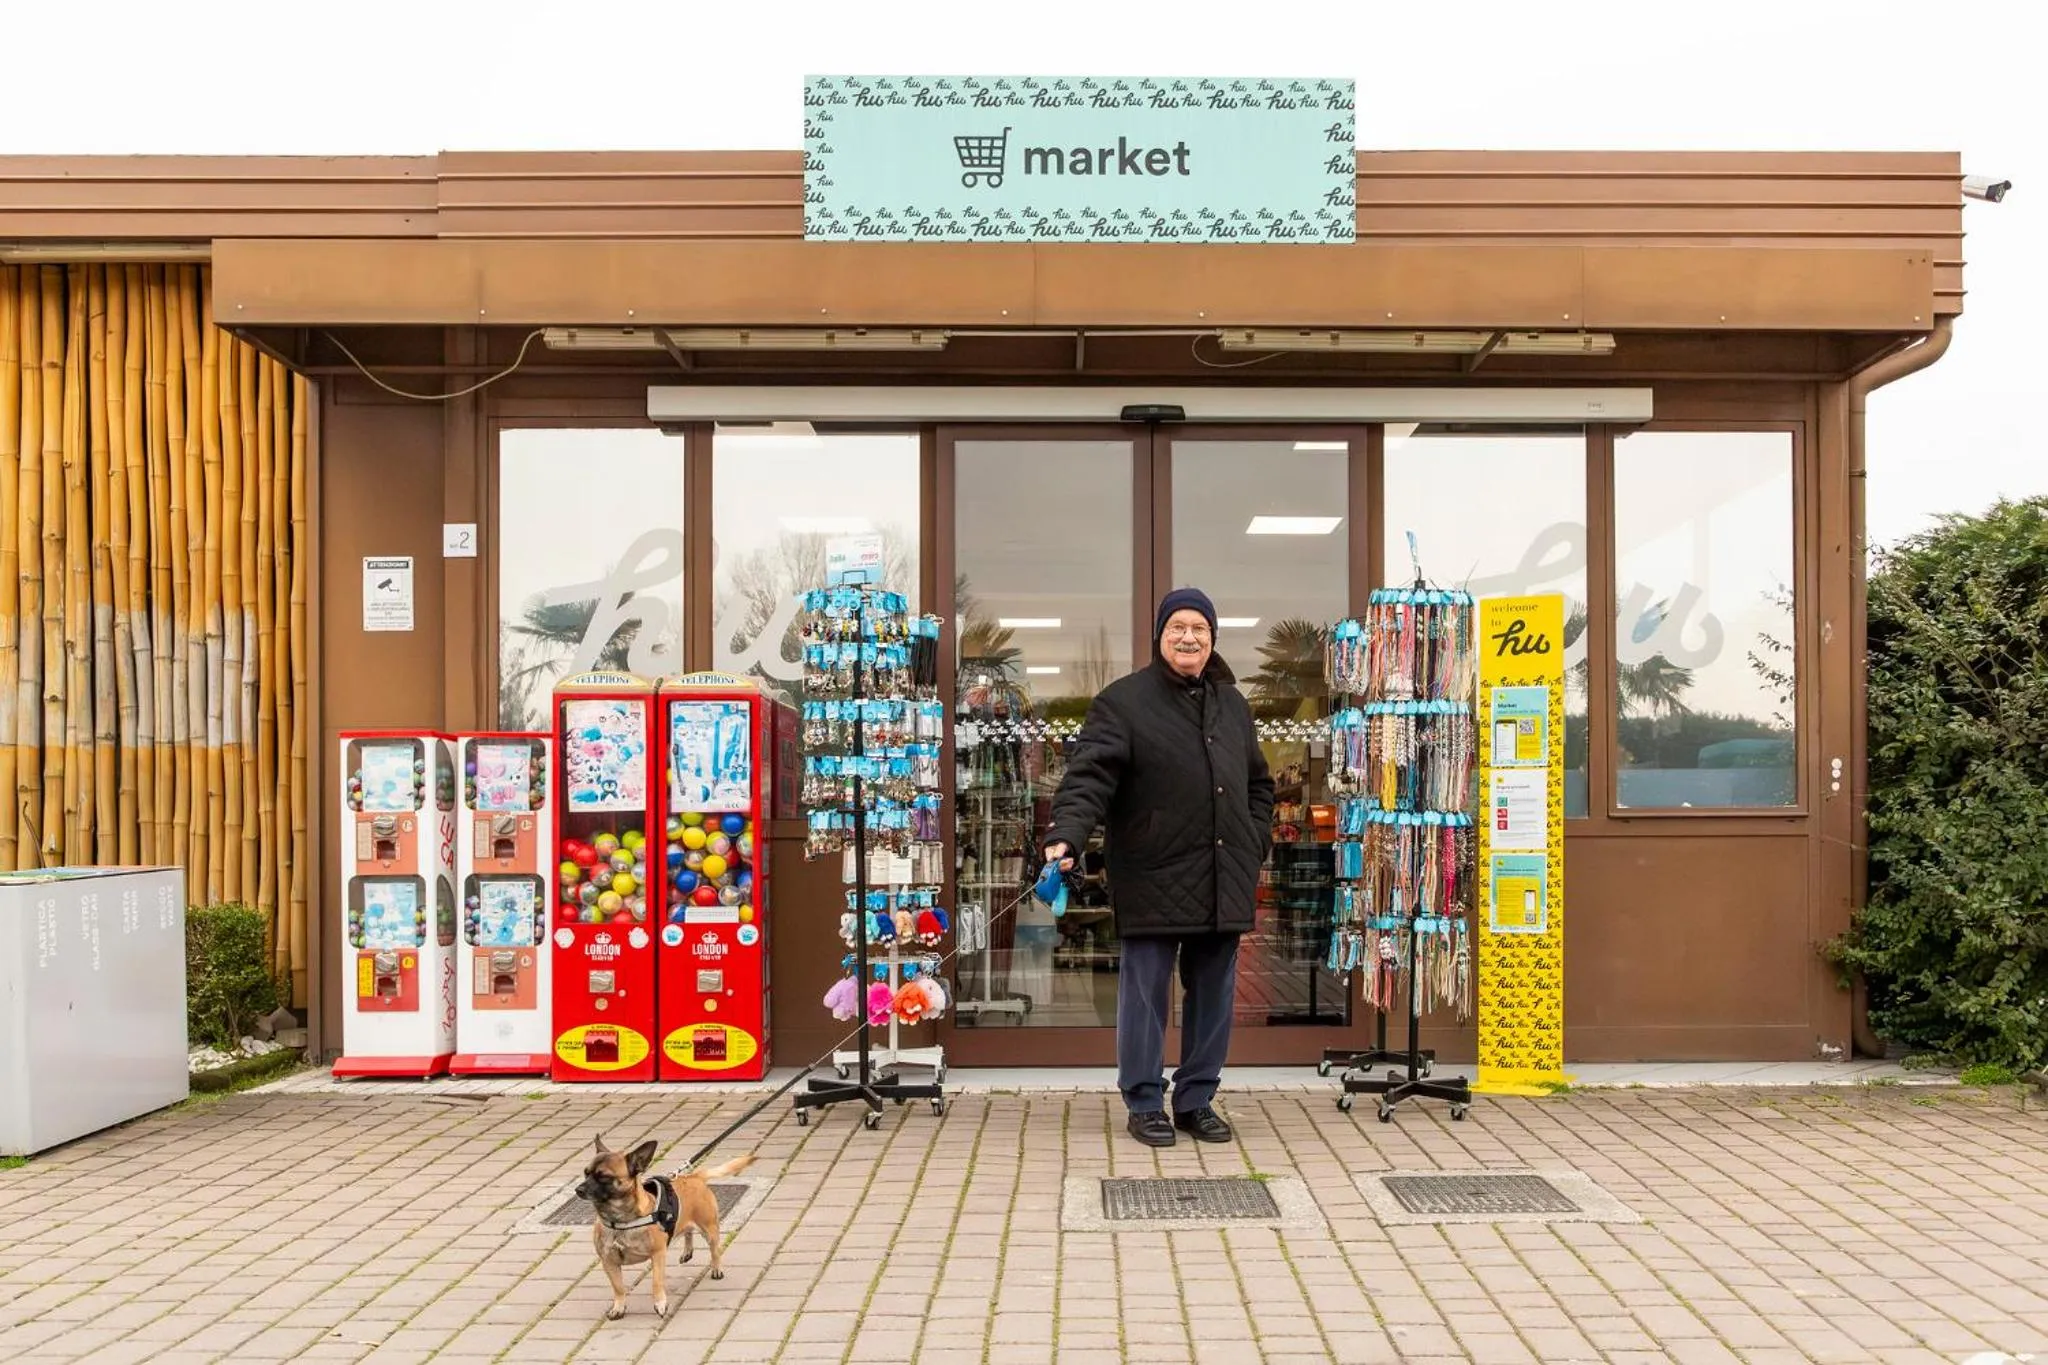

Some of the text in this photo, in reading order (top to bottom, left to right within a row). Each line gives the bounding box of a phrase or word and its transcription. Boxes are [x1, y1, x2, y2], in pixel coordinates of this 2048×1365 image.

[816, 76, 1333, 92] hu hu hu hu hu hu hu hu hu hu hu hu hu hu hu hu hu hu
[826, 91, 848, 104] hu
[852, 87, 884, 107] hu
[885, 91, 907, 104] hu
[911, 87, 943, 108] hu
[944, 91, 966, 105] hu
[970, 88, 1002, 108] hu
[1004, 92, 1025, 106] hu
[1029, 88, 1061, 108] hu
[1063, 92, 1084, 106] hu
[1088, 88, 1120, 108] hu
[1122, 92, 1143, 106] hu
[1148, 88, 1179, 108] hu
[1181, 92, 1202, 107] hu
[1206, 90, 1238, 109] hu
[1240, 94, 1260, 107] hu
[1265, 90, 1296, 110] hu
[1298, 94, 1319, 108] hu
[1324, 90, 1355, 110] hu
[817, 110, 833, 121] hu
[1324, 122, 1355, 142] hu
[817, 143, 834, 154] hu
[1024, 136, 1190, 176] market
[1324, 154, 1355, 174] hu
[816, 174, 834, 186] hu
[1324, 187, 1355, 206] hu
[816, 207, 833, 219] hu
[844, 205, 862, 217] hu
[876, 207, 893, 219] hu
[903, 206, 921, 217] hu
[935, 207, 952, 219] hu
[963, 206, 980, 218] hu
[994, 207, 1011, 219] hu
[1021, 206, 1039, 218] hu
[1052, 208, 1071, 219] hu
[1081, 207, 1098, 218] hu
[1111, 208, 1129, 220] hu
[1139, 207, 1157, 219] hu
[1170, 209, 1188, 220] hu
[1197, 207, 1216, 219] hu
[1230, 209, 1247, 220] hu
[1256, 207, 1274, 219] hu
[1288, 210, 1305, 221] hu
[1314, 208, 1333, 220] hu
[827, 220, 848, 234] hu
[853, 216, 884, 236] hu
[886, 220, 907, 234] hu
[912, 216, 943, 236] hu
[945, 220, 966, 234] hu
[970, 217, 1002, 236] hu
[1004, 221, 1026, 234] hu
[1030, 217, 1061, 237] hu
[1063, 221, 1084, 235] hu
[1089, 217, 1120, 237] hu
[1122, 222, 1143, 235] hu
[1148, 218, 1179, 238] hu
[1180, 222, 1202, 235] hu
[1206, 218, 1238, 238] hu
[1239, 222, 1260, 236] hu
[1265, 218, 1296, 238] hu
[1297, 222, 1319, 236] hu
[1324, 219, 1355, 239] hu
[460, 531, 469, 549] 2
[1492, 603, 1538, 612] welcome
[1491, 618, 1550, 657] to hu
[576, 674, 630, 684] TELEPHONE
[681, 674, 736, 684] TELEPHONE
[584, 943, 621, 956] LONDON
[692, 943, 728, 955] LONDON
[1496, 936, 1515, 949] hu
[1532, 936, 1552, 950] hu
[1494, 956, 1515, 970] hu
[1532, 957, 1553, 970] hu
[1495, 976, 1515, 989] hu
[1532, 977, 1553, 990] hu
[1495, 996, 1515, 1009] hu
[1494, 1016, 1515, 1029] hu
[1531, 1018, 1552, 1031] hu
[1495, 1036, 1515, 1049] hu
[1532, 1037, 1552, 1051] hu
[1494, 1056, 1515, 1069] hu
[1531, 1058, 1552, 1071] hu
